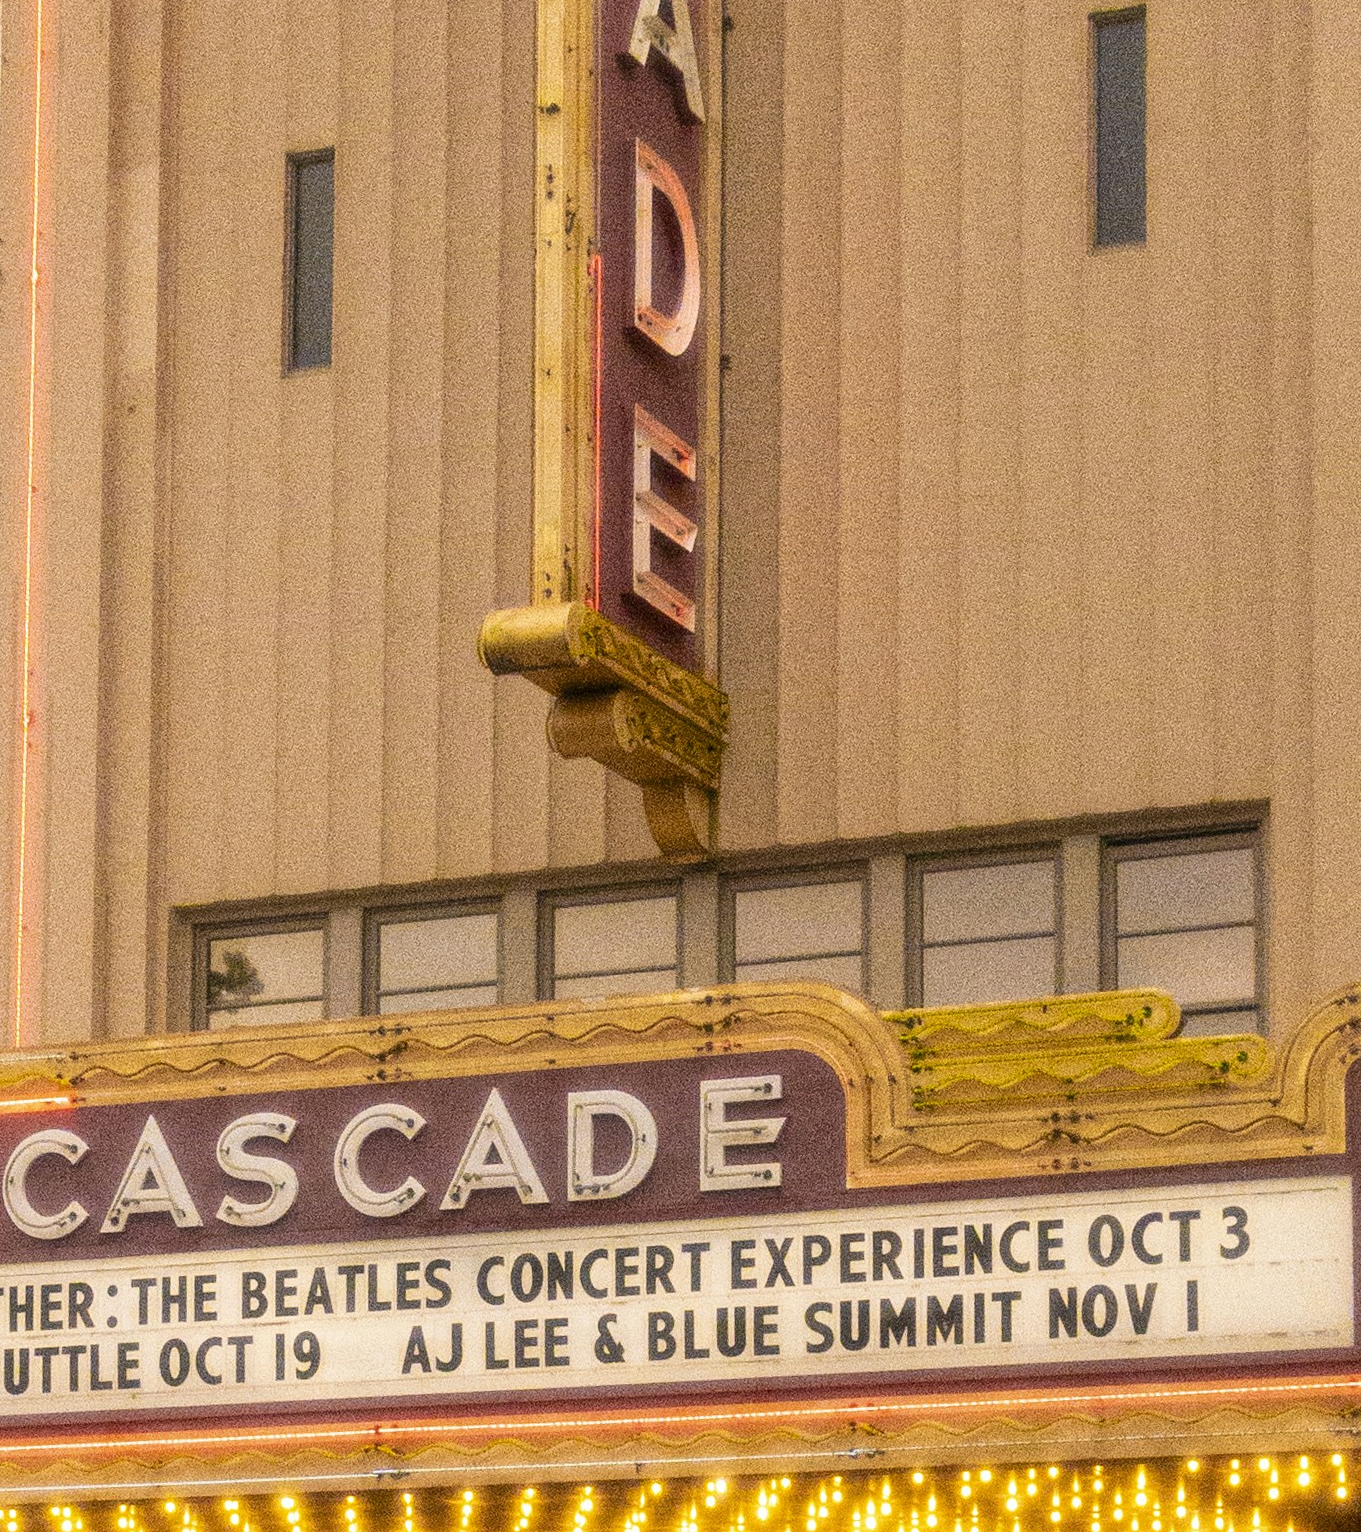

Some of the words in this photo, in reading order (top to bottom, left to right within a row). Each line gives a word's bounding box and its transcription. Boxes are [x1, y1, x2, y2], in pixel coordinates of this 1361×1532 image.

[0, 1071, 787, 1242] CASCADE
[132, 1275, 217, 1324] THE
[242, 1258, 453, 1320] BEATLES
[476, 1242, 710, 1306] CONCERT
[730, 1219, 1065, 1290] EXPERIENCE
[1088, 1210, 1201, 1268] OCT
[1222, 1206, 1251, 1259] 3
[159, 1335, 253, 1389] OCT
[275, 1331, 322, 1380] 19
[401, 1323, 464, 1375] AJ
[485, 1317, 570, 1370] LEE
[593, 1313, 625, 1365] &
[648, 1305, 781, 1361] BLUE
[804, 1290, 1022, 1355] SUMMIT
[1048, 1283, 1157, 1340] NOV
